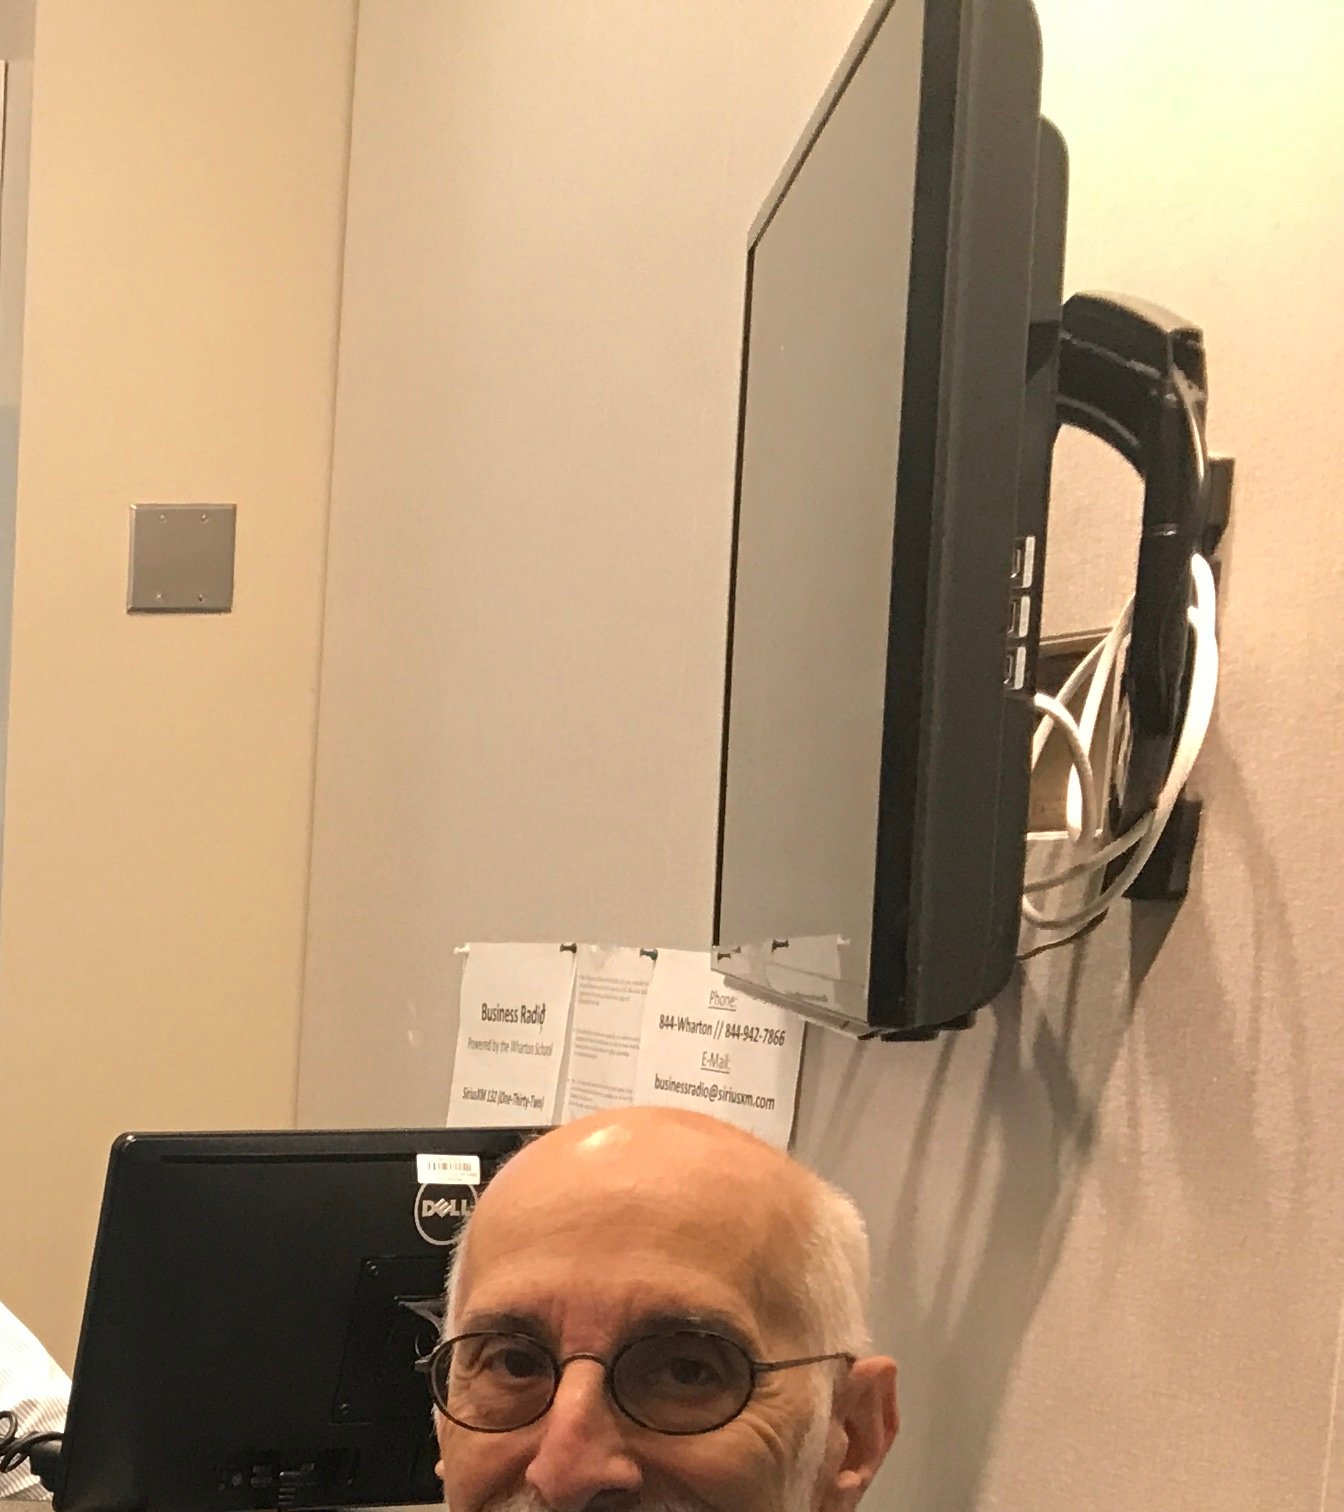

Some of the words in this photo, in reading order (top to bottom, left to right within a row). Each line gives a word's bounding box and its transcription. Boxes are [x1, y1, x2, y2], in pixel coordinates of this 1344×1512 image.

[481, 1002, 519, 1024] Business
[659, 1013, 713, 1037] 844-Wharton
[713, 1019, 725, 1041] //
[724, 1023, 787, 1047] 844-942-7866
[654, 1073, 776, 1110] businessradio@siriusxm.com
[421, 1198, 472, 1218] DELL
